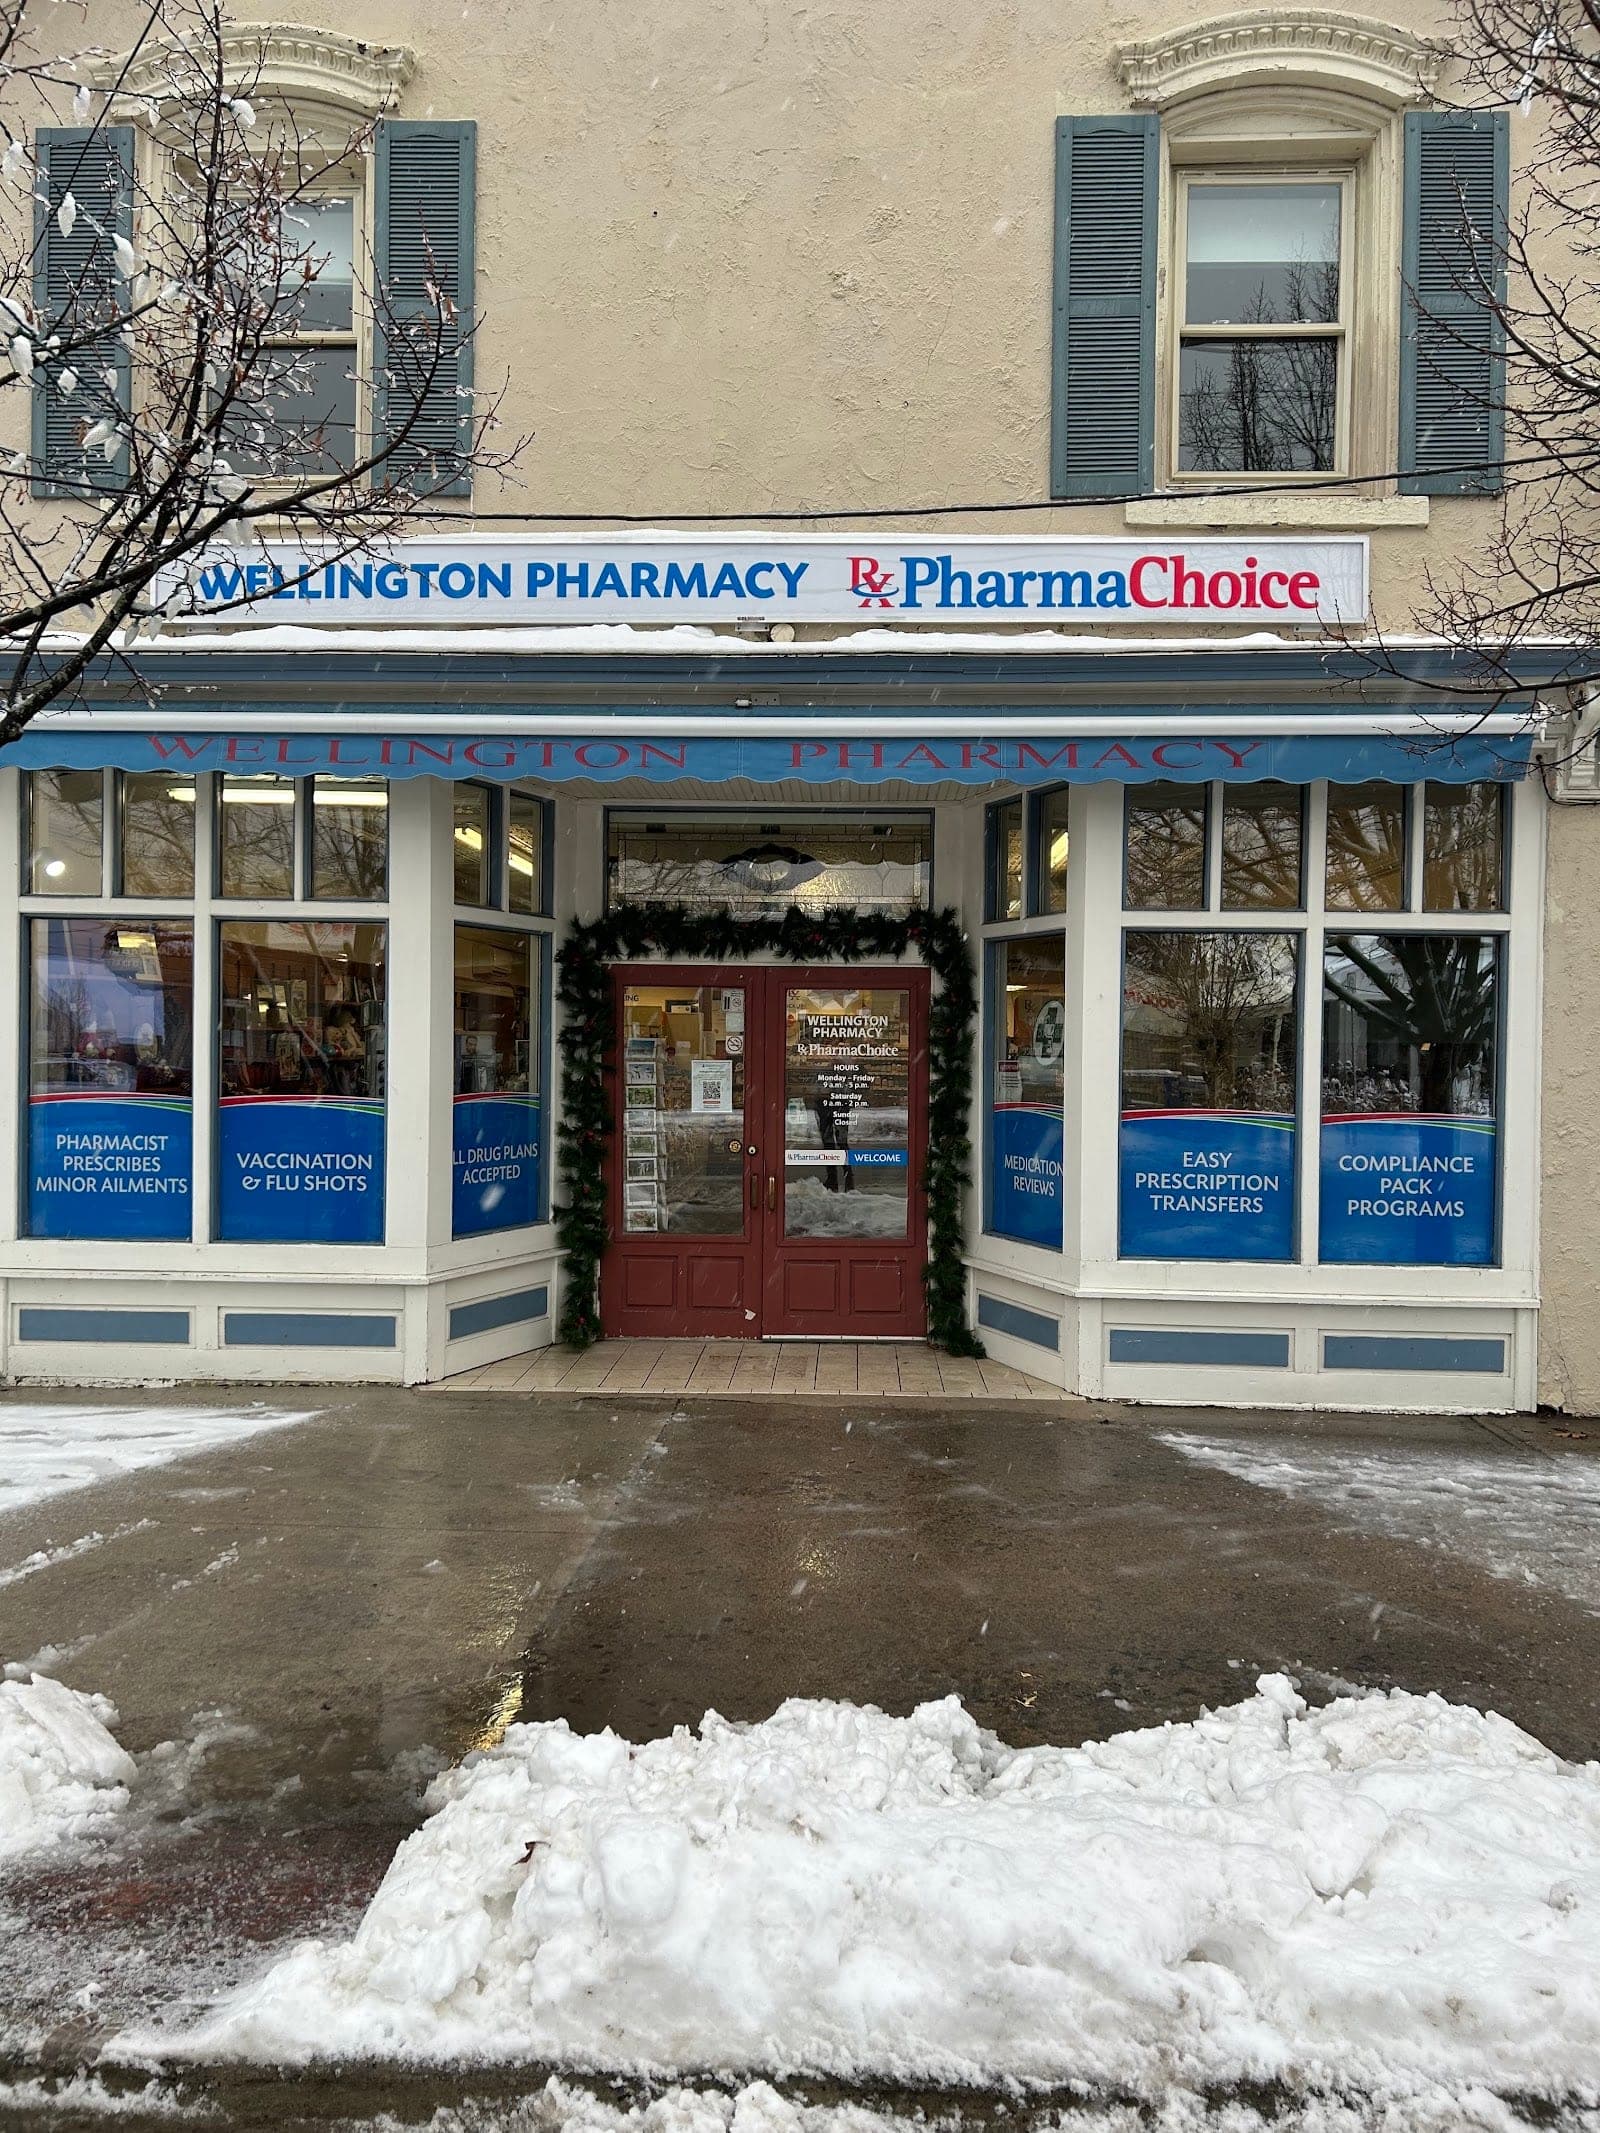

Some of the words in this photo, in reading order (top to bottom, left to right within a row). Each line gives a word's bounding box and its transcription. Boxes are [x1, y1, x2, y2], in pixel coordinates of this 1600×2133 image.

[199, 563, 511, 600] WELLINGTON
[527, 563, 808, 599] PHARMACY
[146, 735, 687, 769] WELLINGTON
[786, 743, 1264, 769] PHARMACY
[807, 1016, 888, 1026] WELLINGTON
[812, 1028, 883, 1038] PHARMACY
[817, 1074, 847, 1082] Monday
[853, 1074, 875, 1082] Friday
[830, 1092, 862, 1101] Saturday
[832, 1111, 860, 1119] Sunday
[56, 1134, 168, 1151] PHARMACIST
[236, 1153, 373, 1170] VACCINATION
[467, 1147, 501, 1164] DRUG
[503, 1143, 539, 1160] PLANS
[854, 1154, 901, 1162] WELCOME
[1183, 1151, 1232, 1168] EASY
[63, 1156, 161, 1172] PRESCRIBES
[1004, 1154, 1063, 1176] MEDICATION
[1339, 1155, 1475, 1173] COMPLIANCE
[242, 1176, 261, 1190] &
[266, 1175, 300, 1191] FLU
[304, 1175, 368, 1191] SHOTS
[462, 1165, 521, 1184] ACCEPTED
[1135, 1172, 1279, 1191] PRESCRIPTION
[36, 1177, 98, 1193] MINOR
[100, 1178, 188, 1194] AILMENTS
[1013, 1175, 1055, 1197] REVIEWS
[1380, 1177, 1433, 1194] PACK
[1150, 1194, 1264, 1213] TRANSFERS
[1347, 1200, 1465, 1217] PROGRAMS
